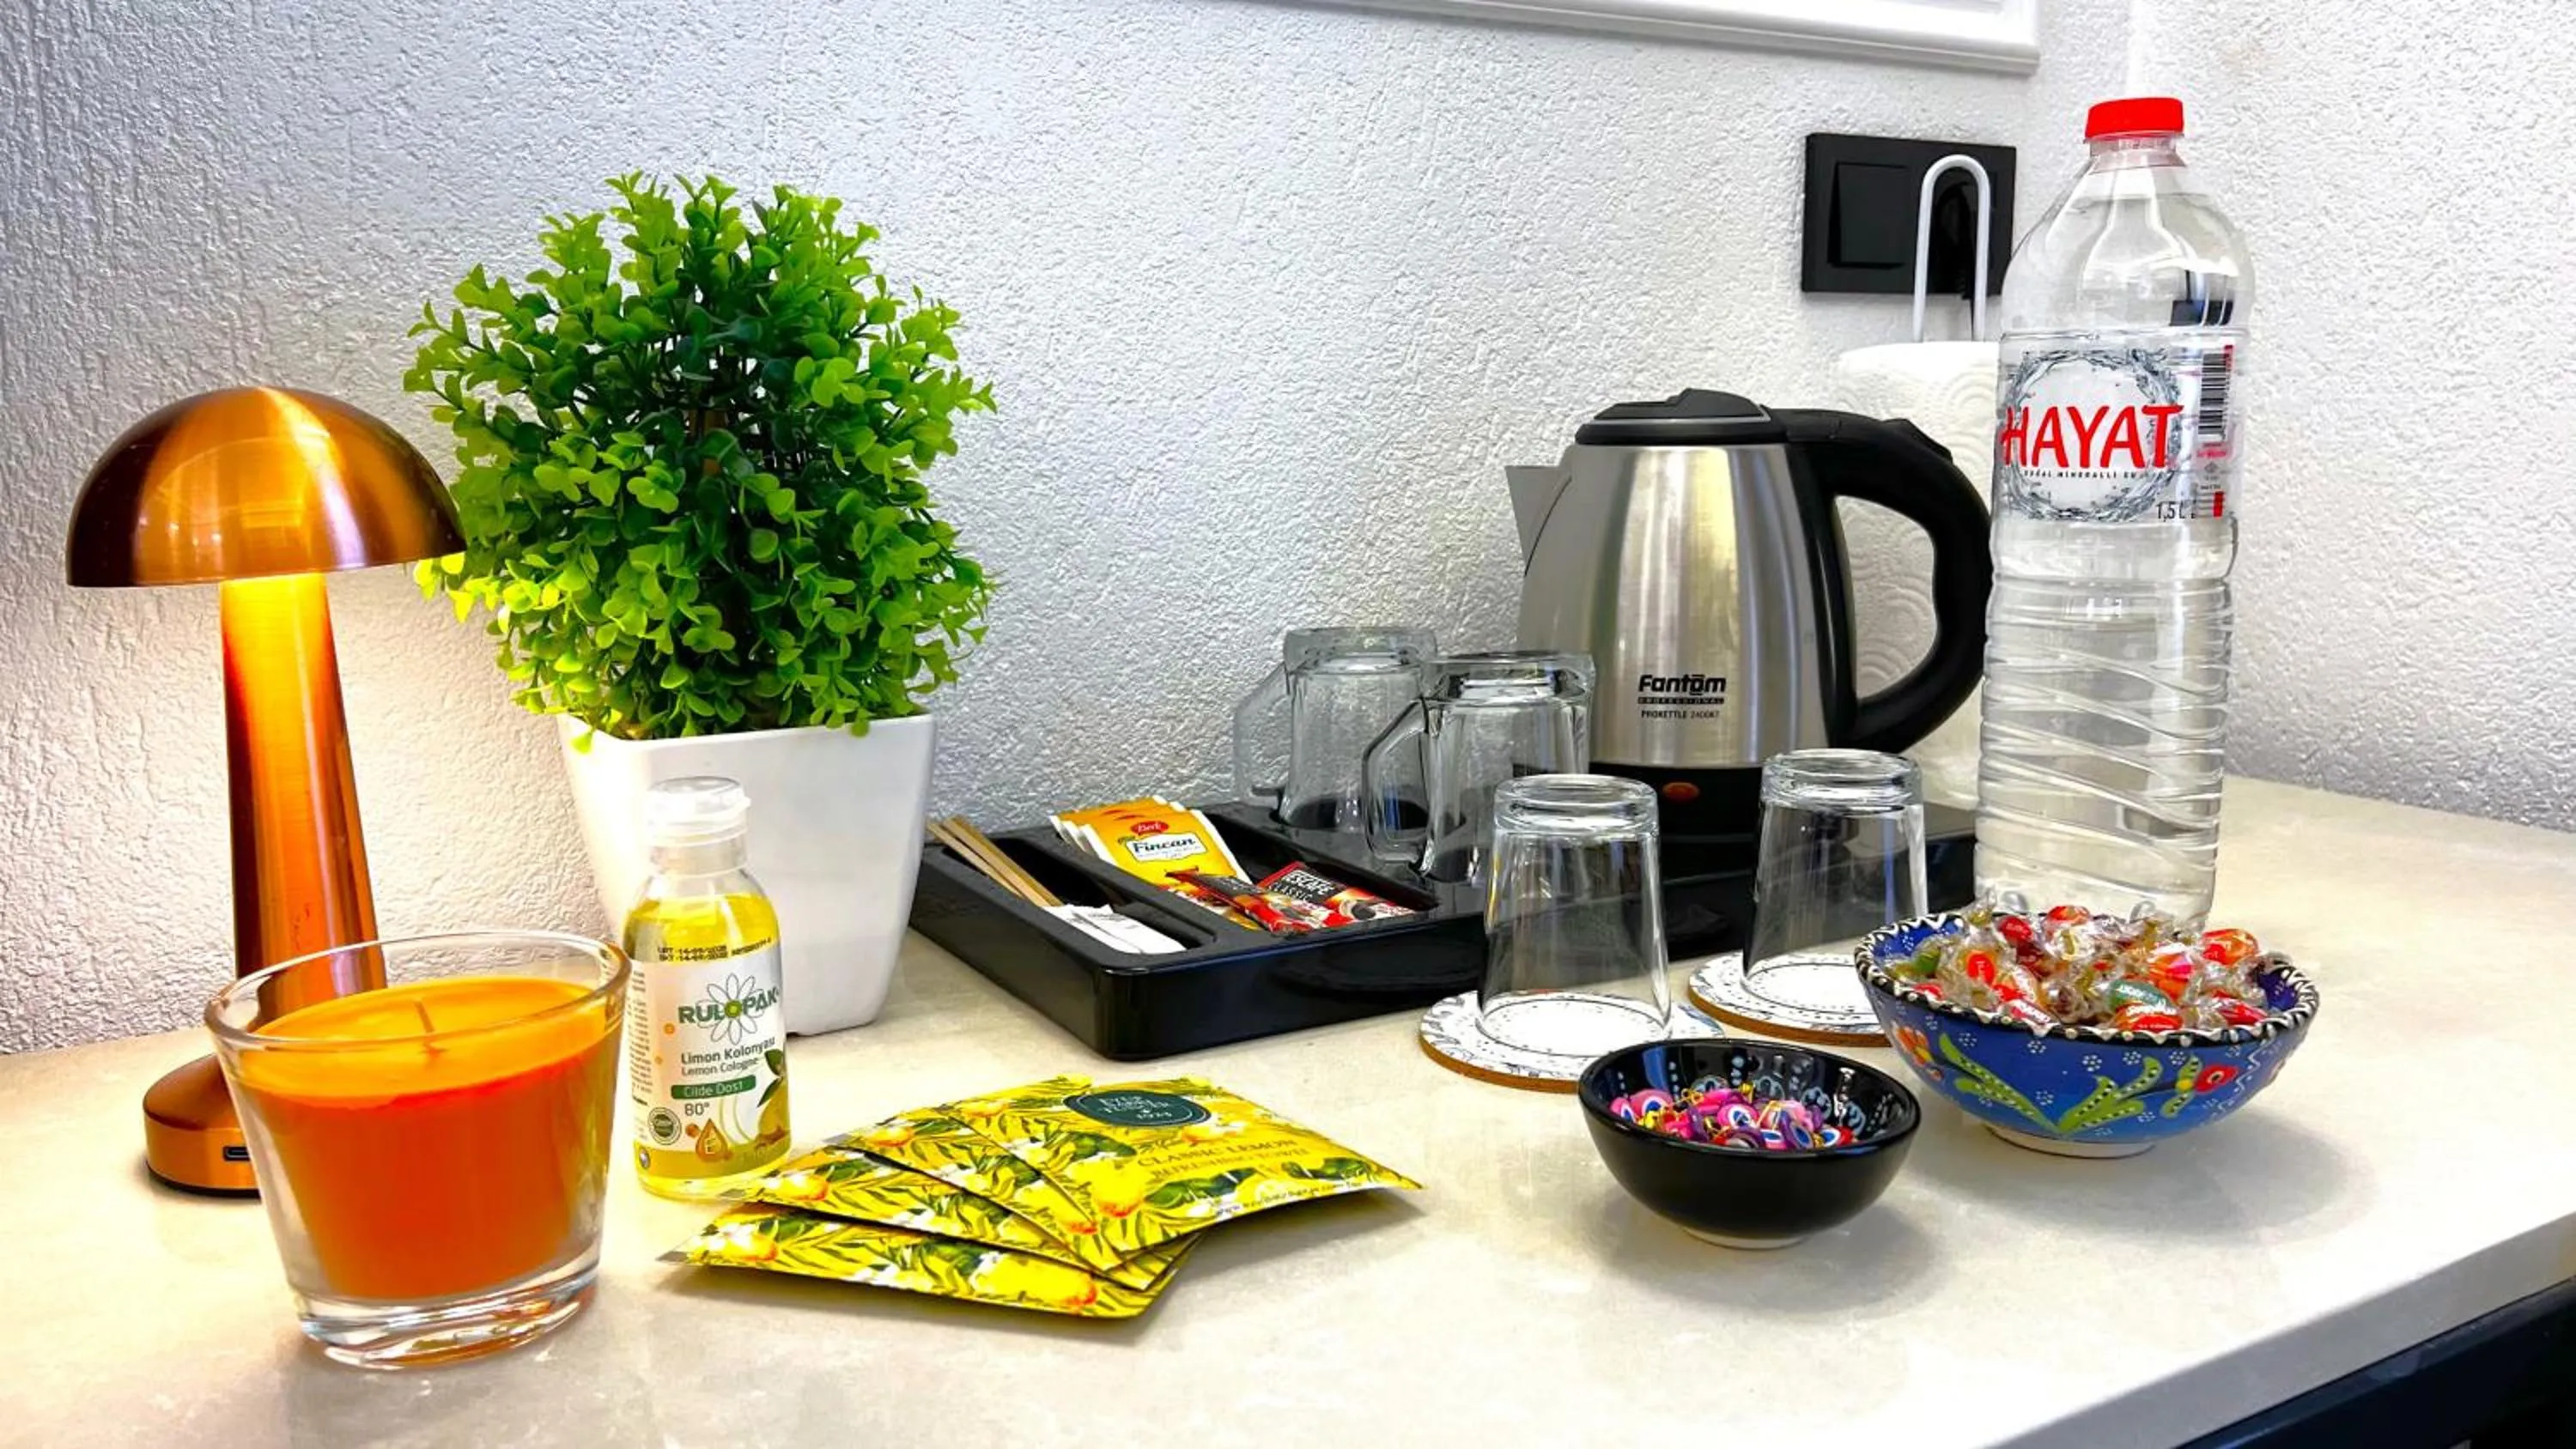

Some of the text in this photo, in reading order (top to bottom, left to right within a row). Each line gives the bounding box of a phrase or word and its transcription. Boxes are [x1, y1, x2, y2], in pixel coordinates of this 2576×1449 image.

[2000, 405, 2184, 469] HAYAT
[1133, 838, 1196, 853] Fincan
[681, 1052, 720, 1065] Limon
[681, 1058, 760, 1076] Lemon Cologne
[683, 1085, 714, 1098] Cilde
[1138, 1139, 1297, 1167] CLASSIC LEMON
